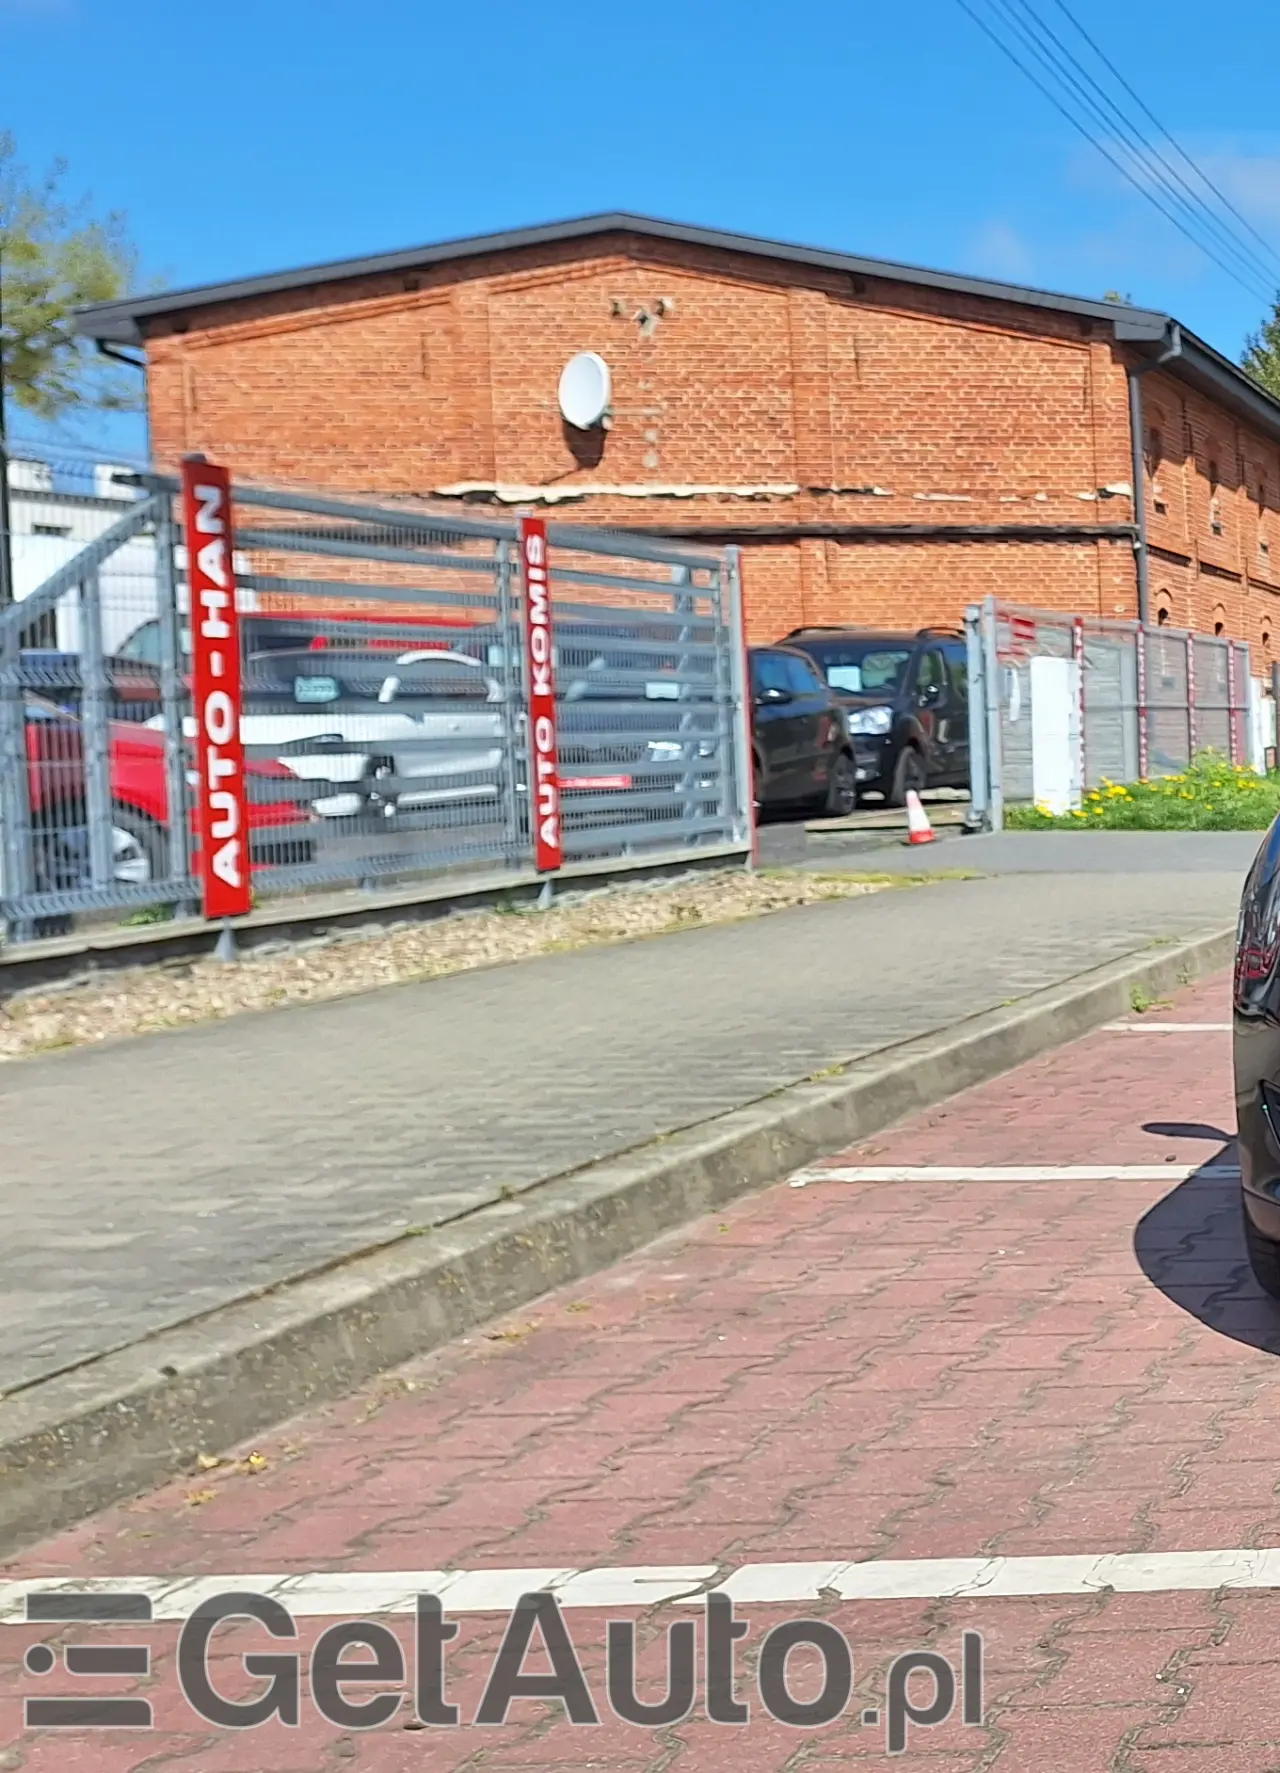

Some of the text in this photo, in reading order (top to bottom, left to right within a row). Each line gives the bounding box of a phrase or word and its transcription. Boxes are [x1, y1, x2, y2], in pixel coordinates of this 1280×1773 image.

[193, 484, 230, 638] HAN
[204, 689, 242, 888] AUTO
[525, 533, 561, 849] AUTO KOMIS
